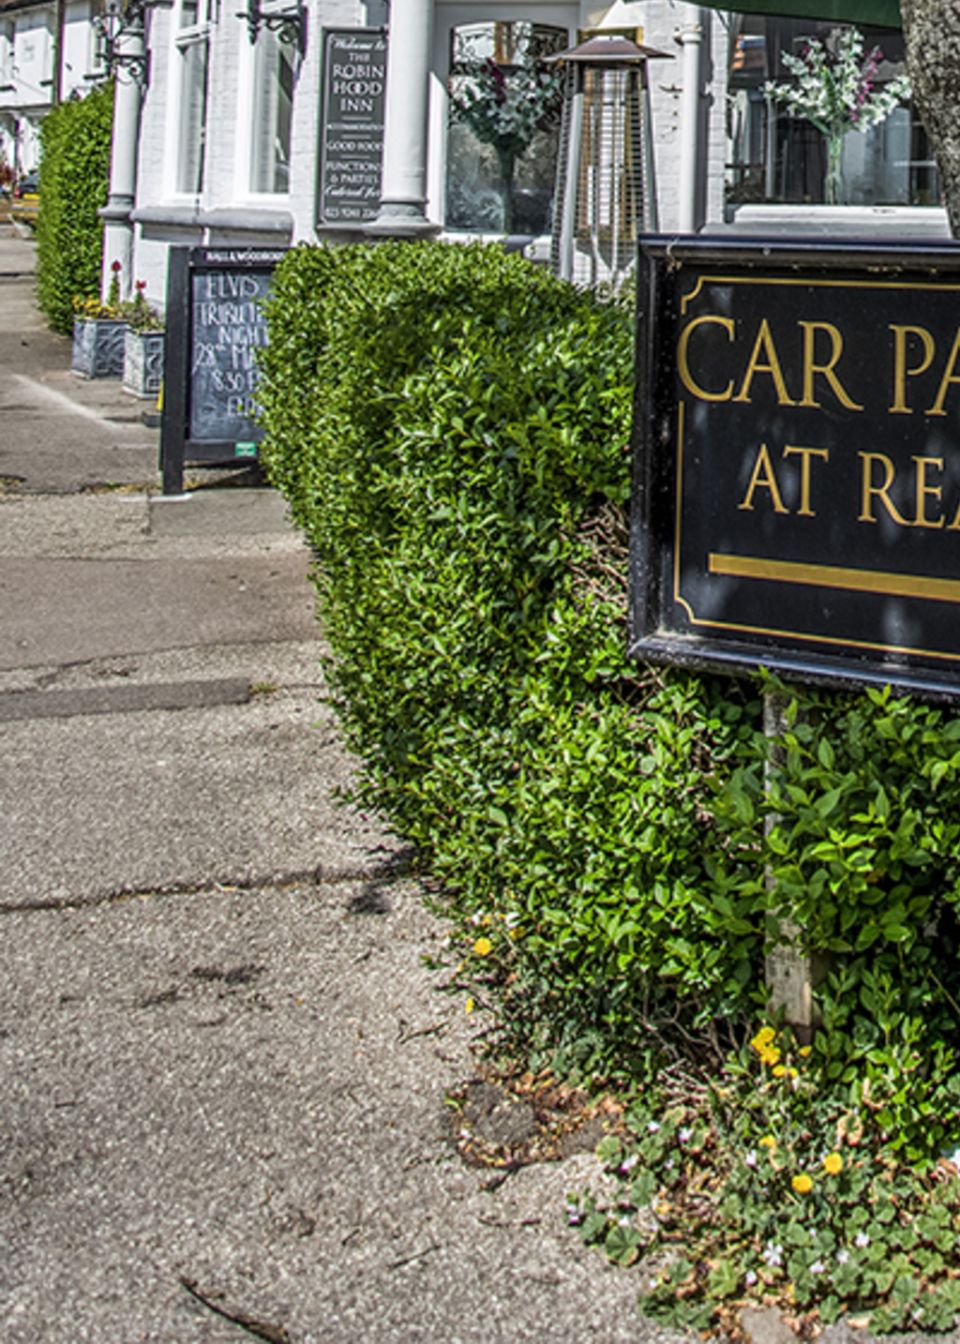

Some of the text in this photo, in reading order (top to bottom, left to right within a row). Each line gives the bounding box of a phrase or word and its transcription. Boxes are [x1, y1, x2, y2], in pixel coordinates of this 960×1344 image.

[348, 52, 371, 63] THE
[332, 64, 385, 79] ROBIN
[332, 81, 382, 95] HOOD
[340, 98, 374, 111] INN
[327, 141, 356, 151] GOOD
[206, 272, 260, 298] ELVIS
[676, 315, 864, 411] CAR
[737, 444, 830, 517] AT
